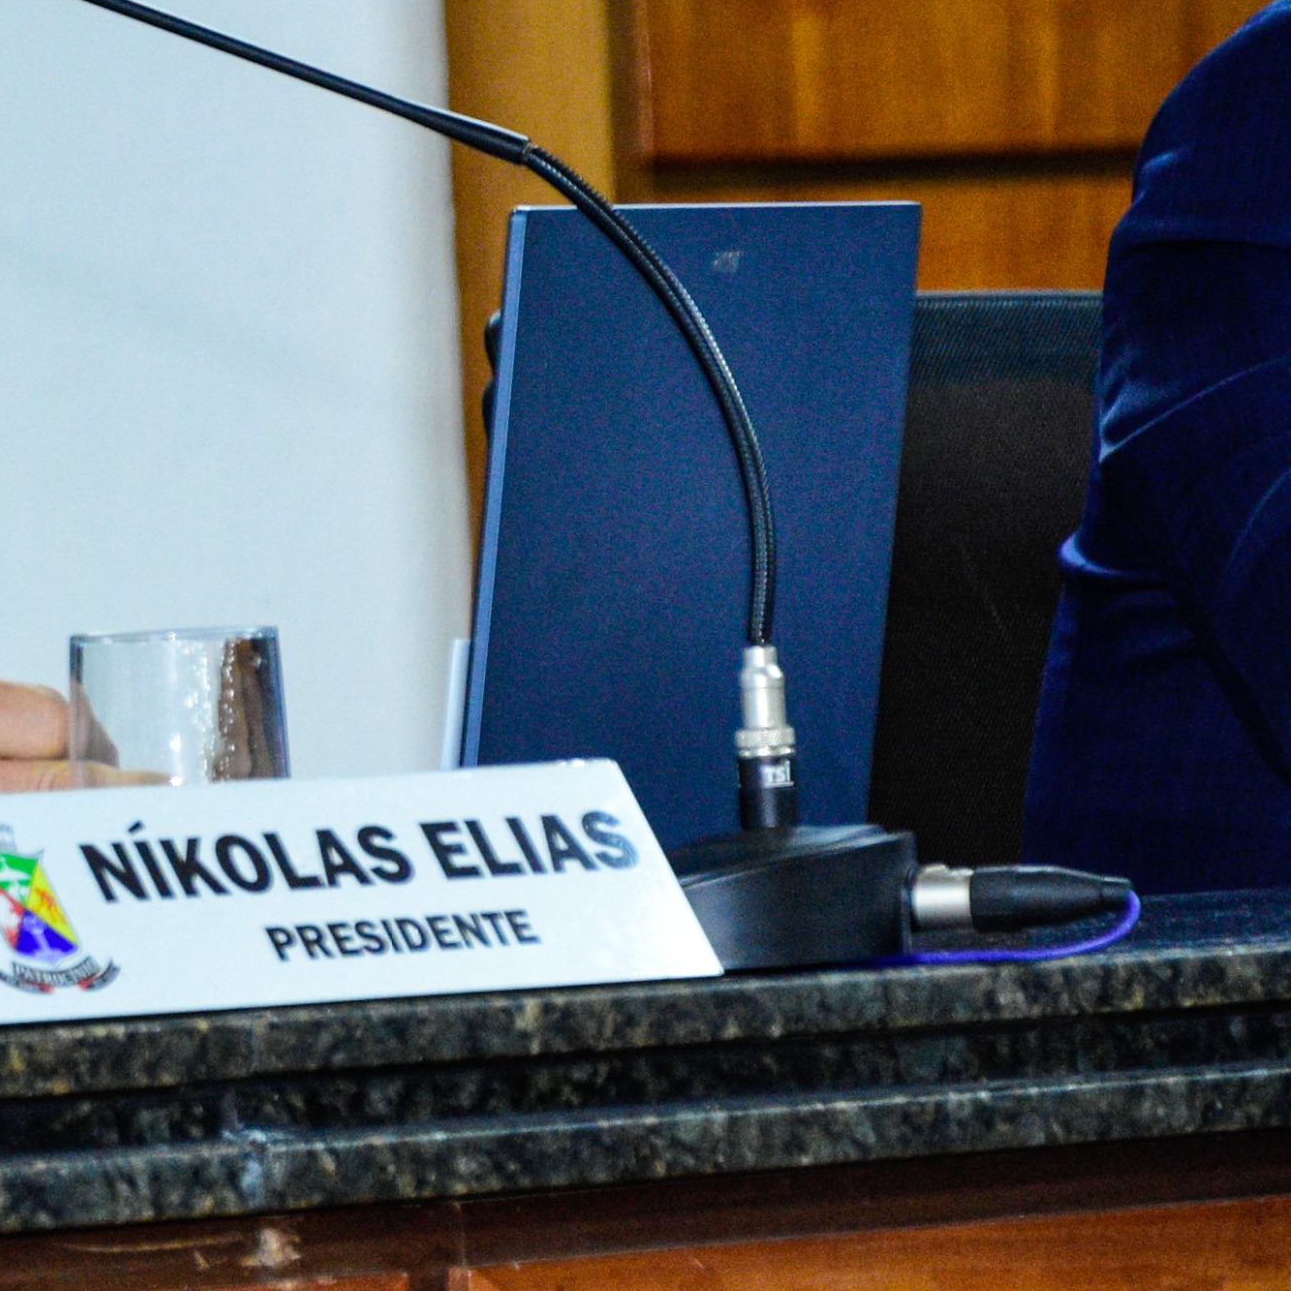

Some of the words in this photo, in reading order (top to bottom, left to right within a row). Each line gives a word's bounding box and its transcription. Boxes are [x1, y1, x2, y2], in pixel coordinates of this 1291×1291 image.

[78, 819, 415, 903] NÍKOLAS
[419, 810, 640, 880] ELIAS
[265, 909, 541, 962] PRESIDENTE
